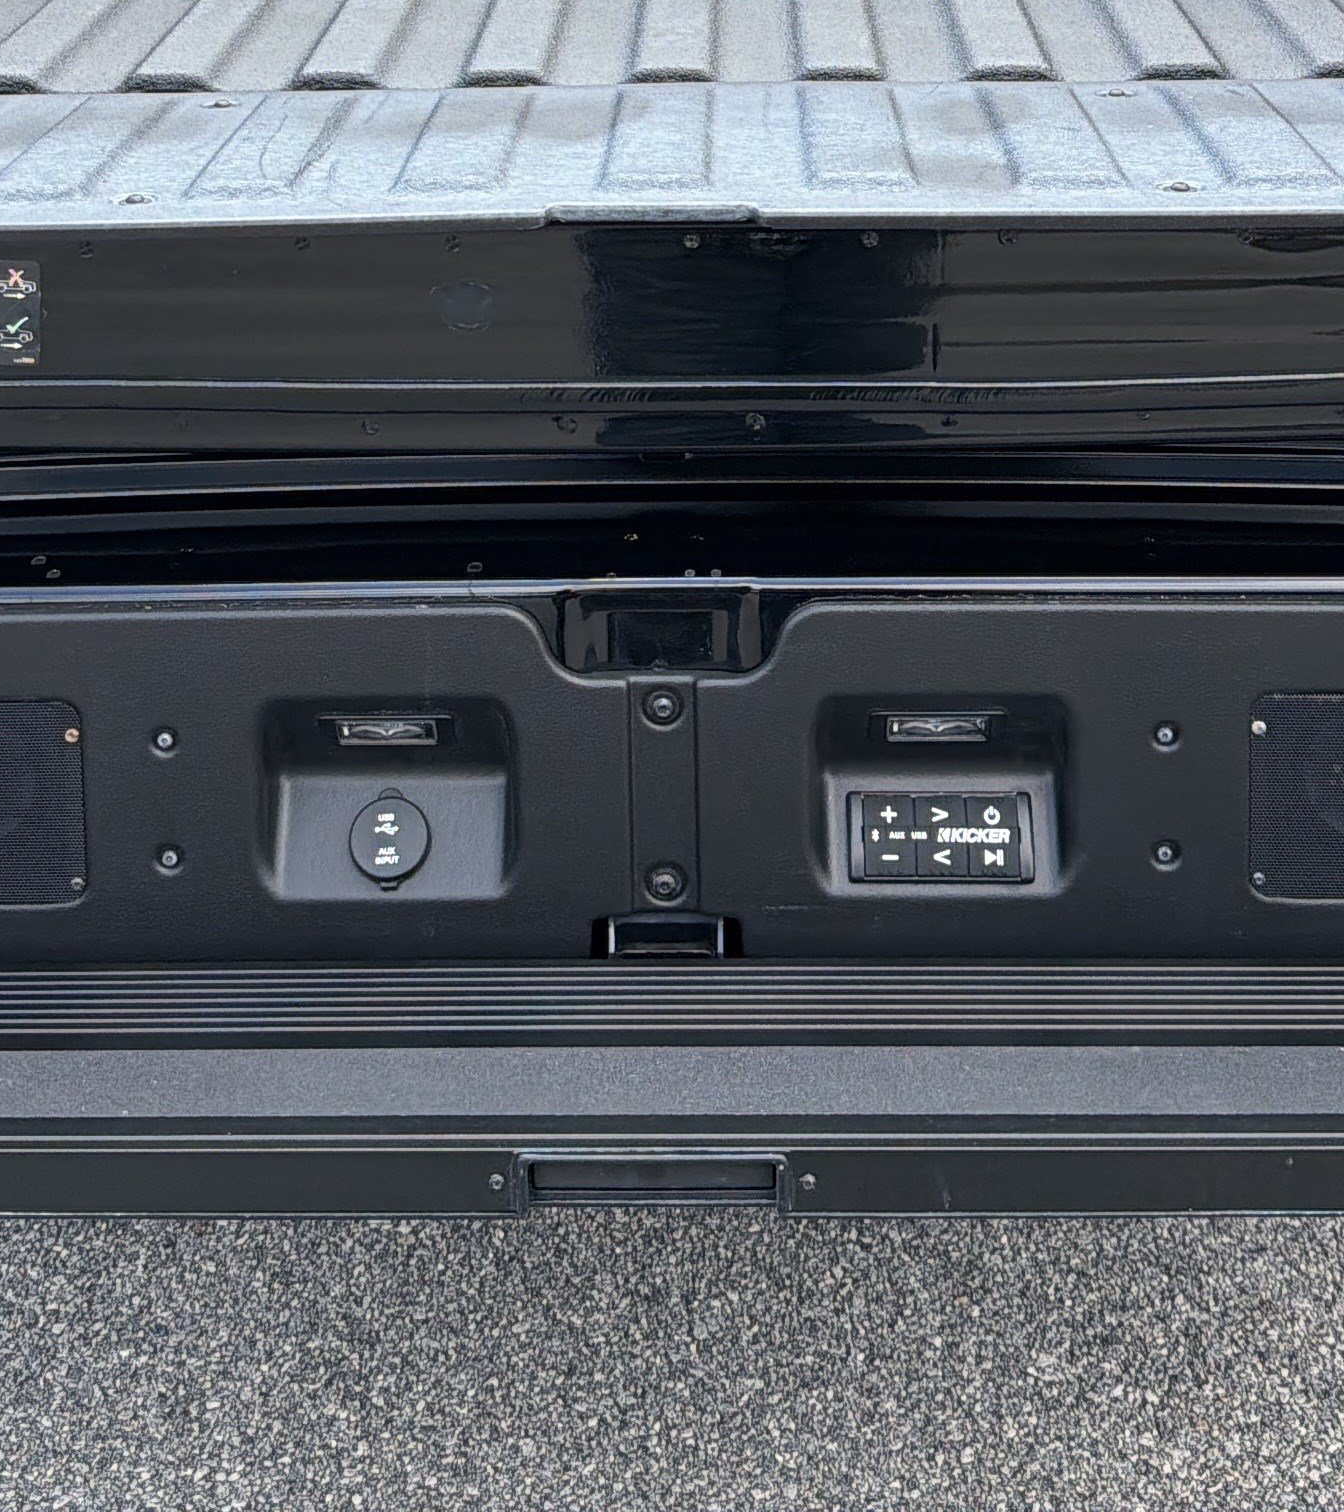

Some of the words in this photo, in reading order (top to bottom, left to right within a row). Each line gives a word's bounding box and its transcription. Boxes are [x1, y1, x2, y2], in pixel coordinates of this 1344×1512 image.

[377, 813, 395, 822] USB
[889, 831, 906, 839] AUX
[911, 831, 928, 840] USB
[951, 828, 1011, 843] KICKER
[378, 847, 397, 855] AUX
[374, 856, 400, 865] INPUT
